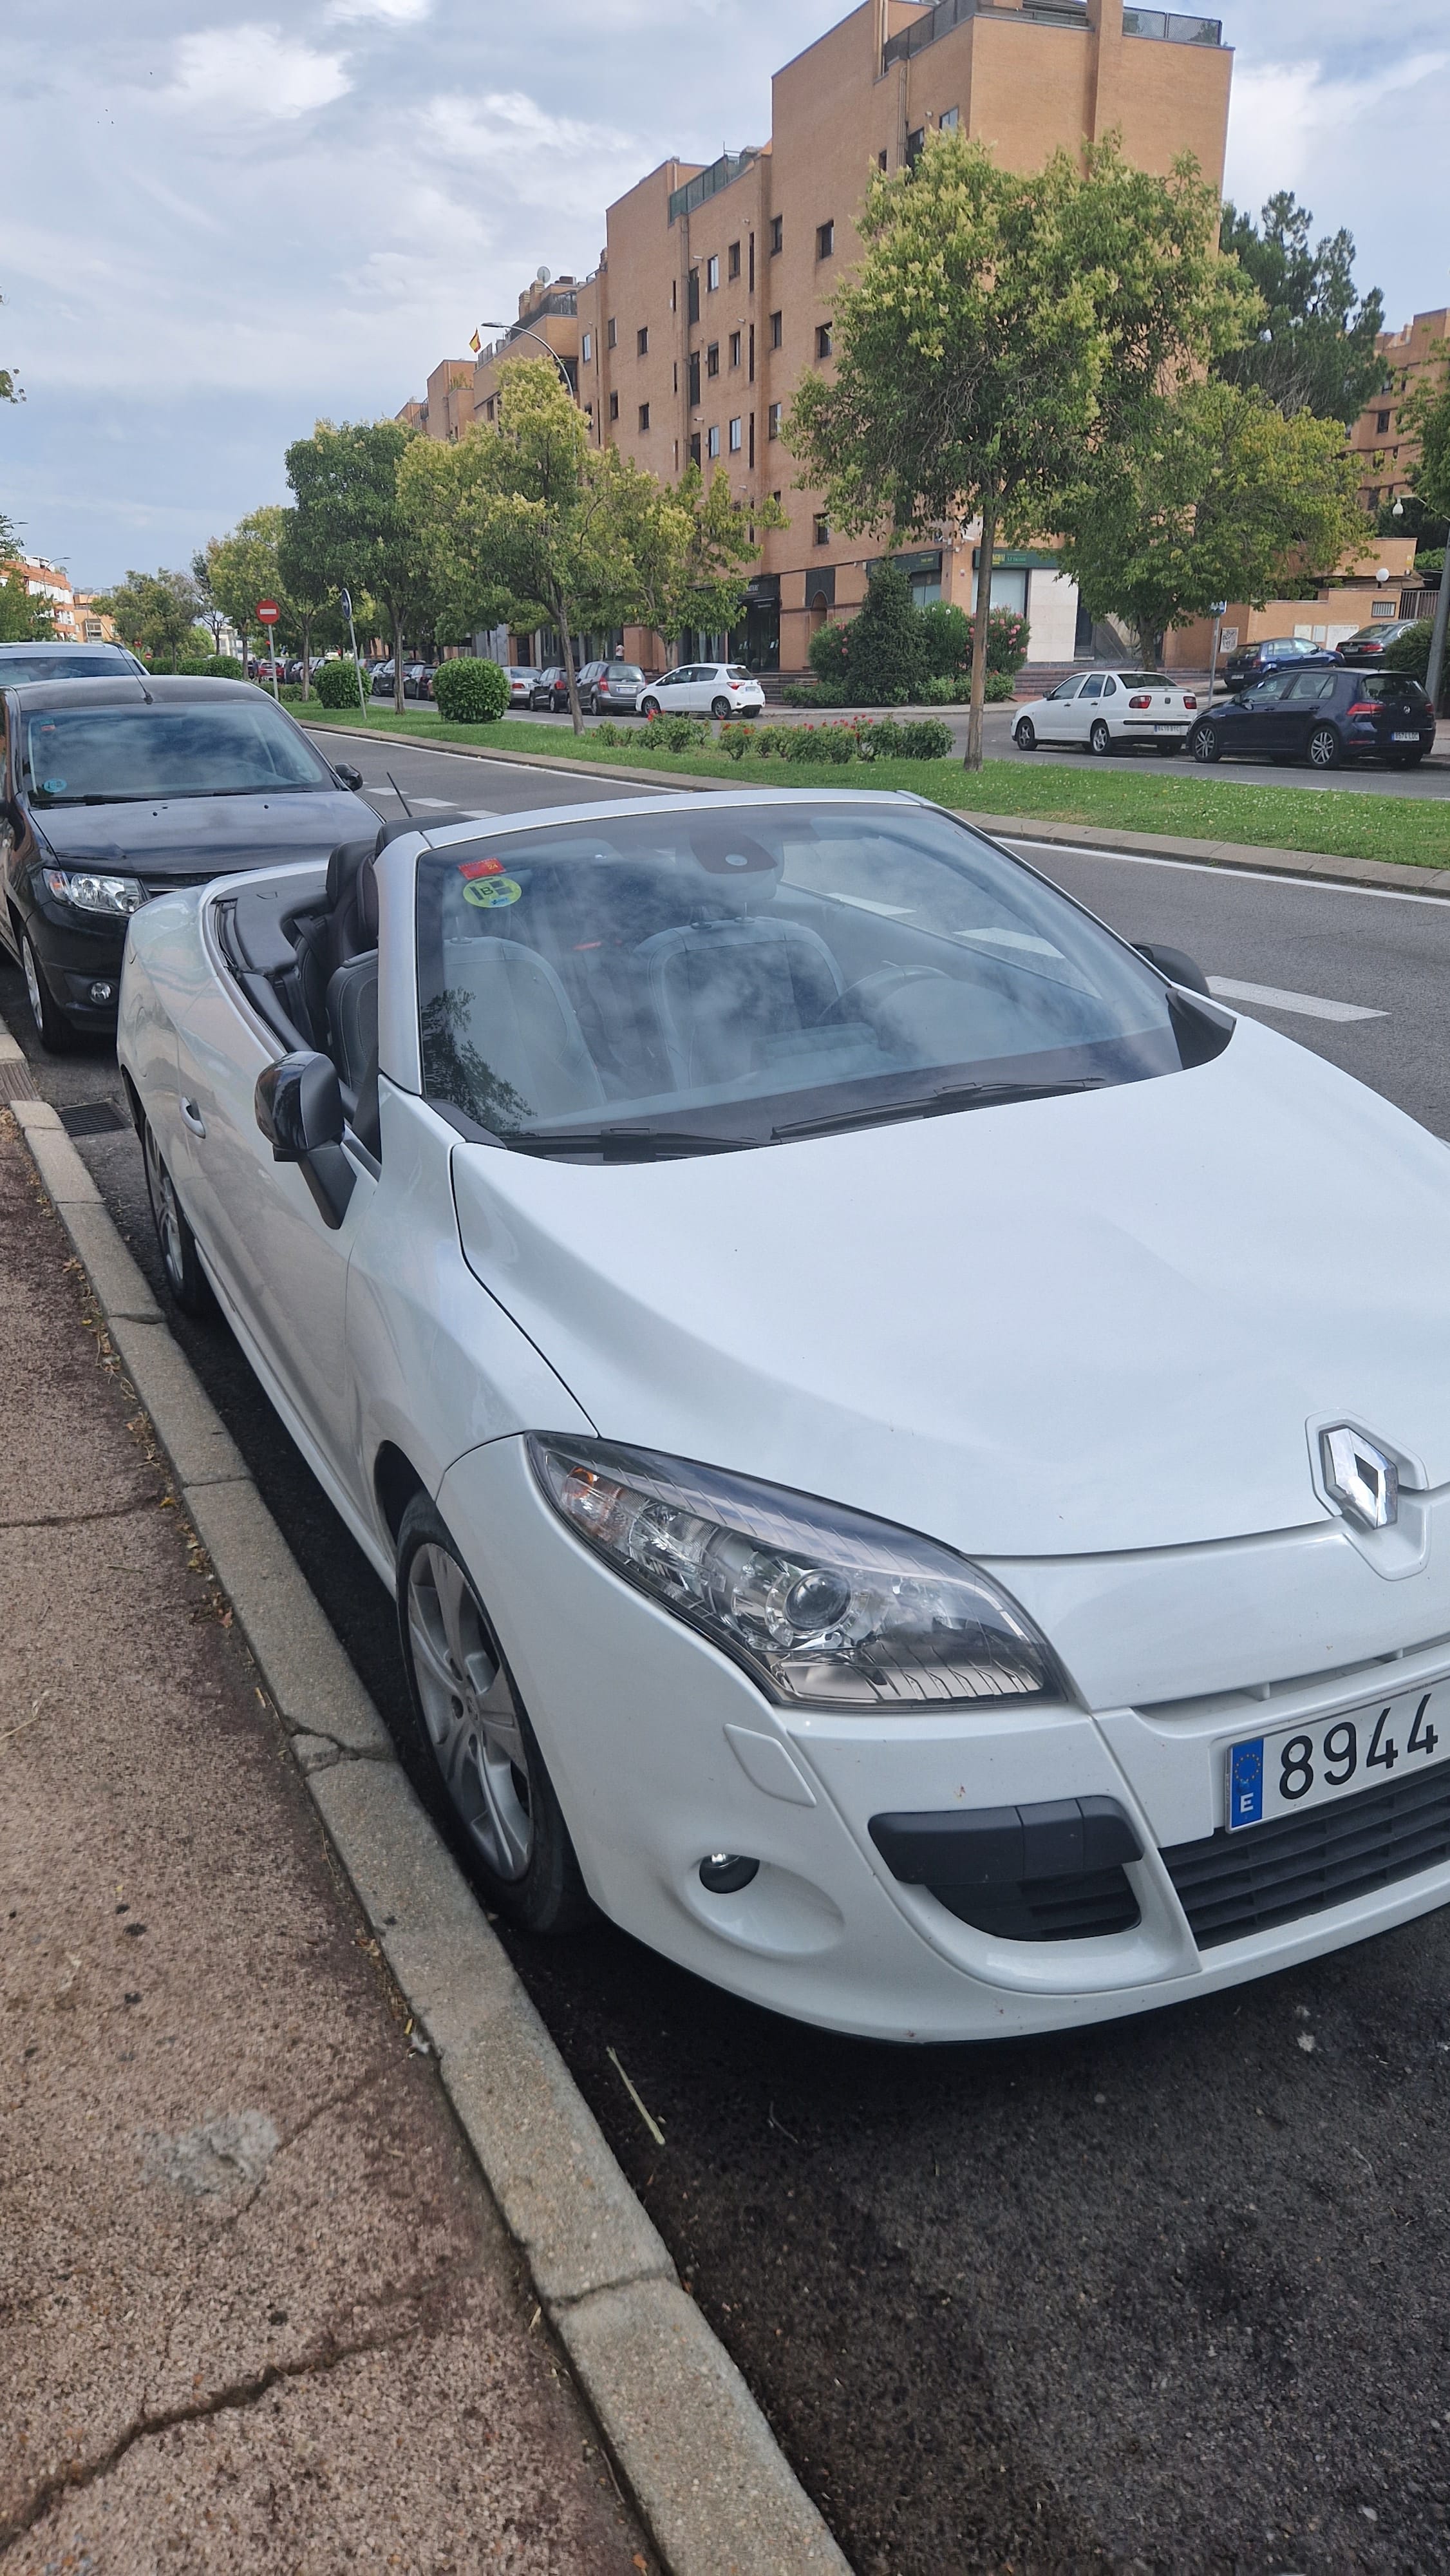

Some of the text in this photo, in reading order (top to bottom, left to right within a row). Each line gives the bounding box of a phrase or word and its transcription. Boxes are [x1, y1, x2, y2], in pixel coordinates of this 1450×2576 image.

[480, 887, 494, 896] B
[1279, 1693, 1438, 1799] 8944
[1240, 1792, 1254, 1814] E
